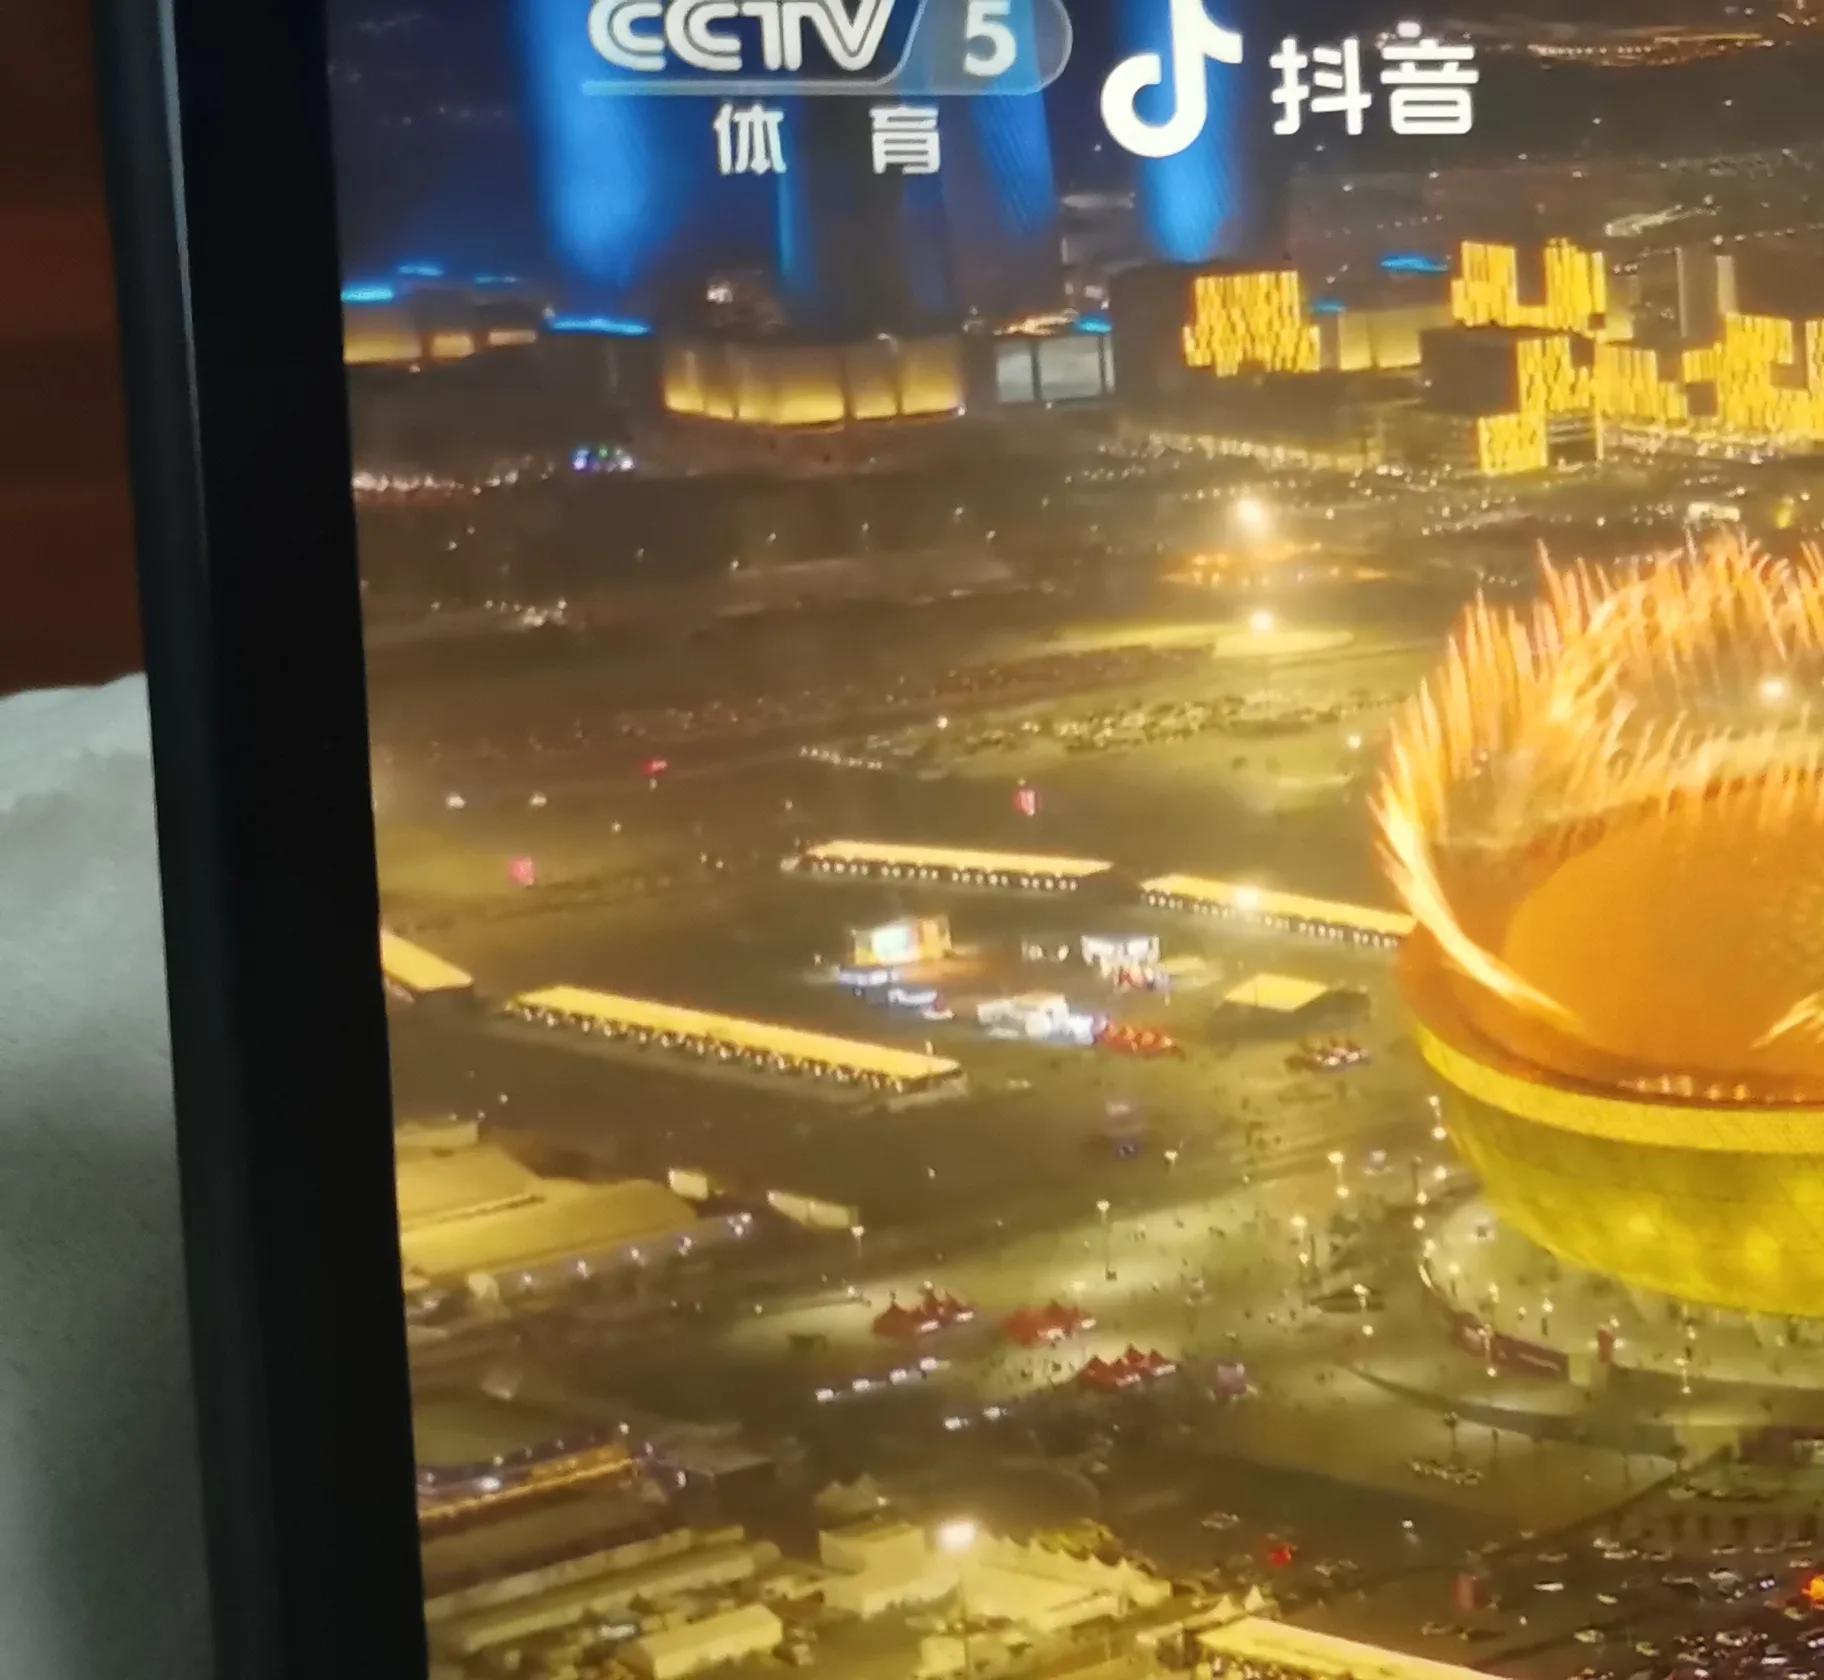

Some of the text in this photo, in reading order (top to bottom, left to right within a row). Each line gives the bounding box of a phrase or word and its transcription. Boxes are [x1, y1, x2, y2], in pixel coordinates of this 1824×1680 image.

[587, 0, 1016, 76] CCTV 5
[1269, 20, 1479, 135] 抖音
[713, 103, 940, 175] 体育
